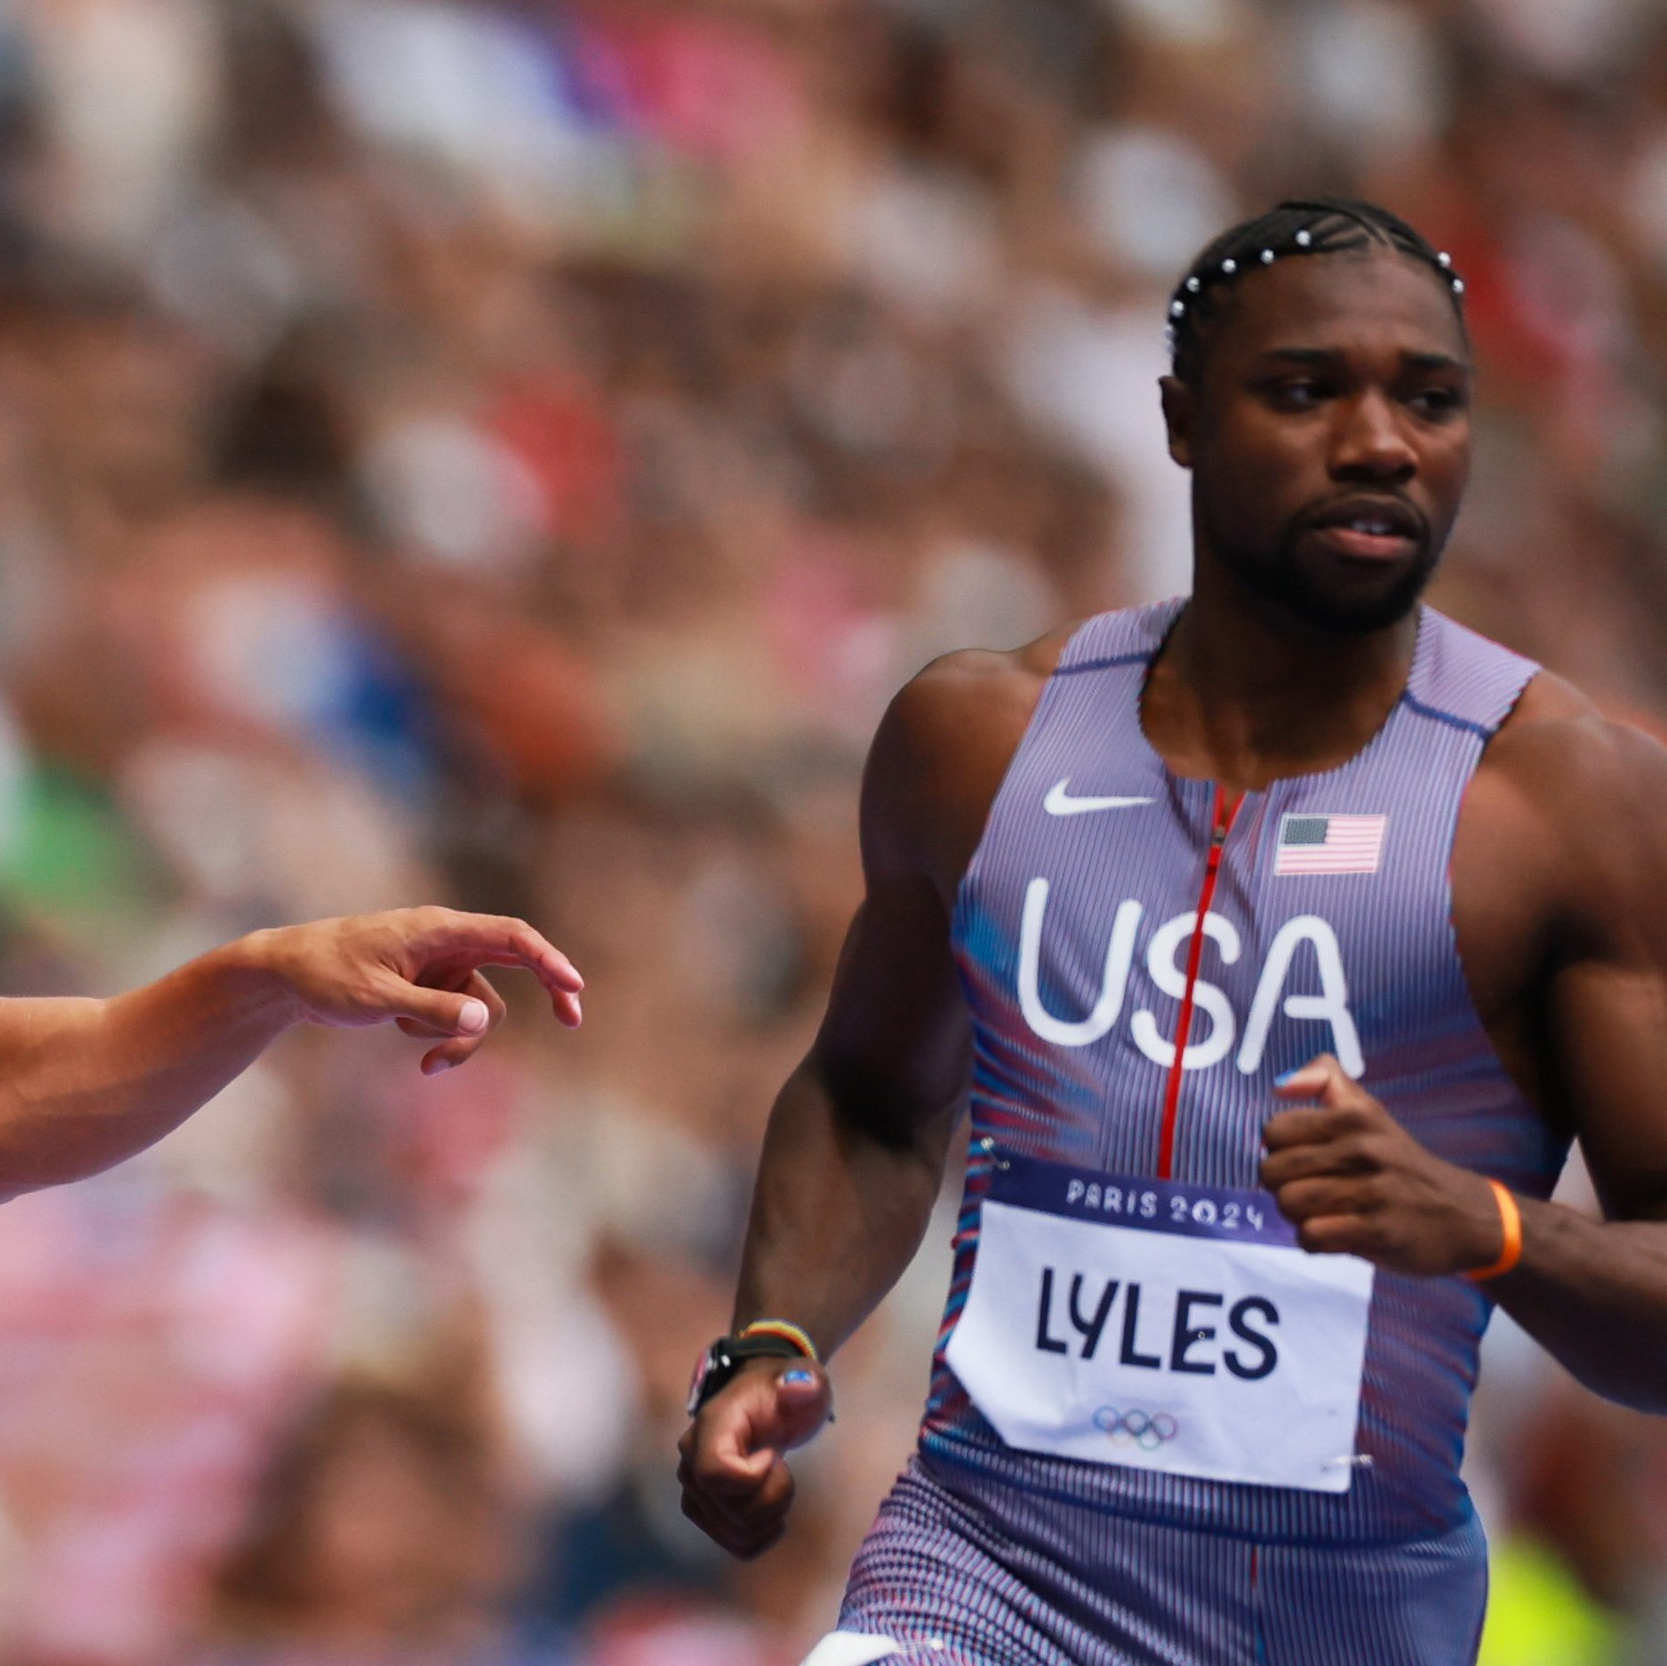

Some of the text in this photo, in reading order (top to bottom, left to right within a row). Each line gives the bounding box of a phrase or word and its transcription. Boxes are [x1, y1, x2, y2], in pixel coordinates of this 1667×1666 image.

[1017, 878, 1365, 1079] USA
[1067, 1179, 1264, 1231] PARIS 2024
[1036, 1266, 1280, 1382] LYLES
